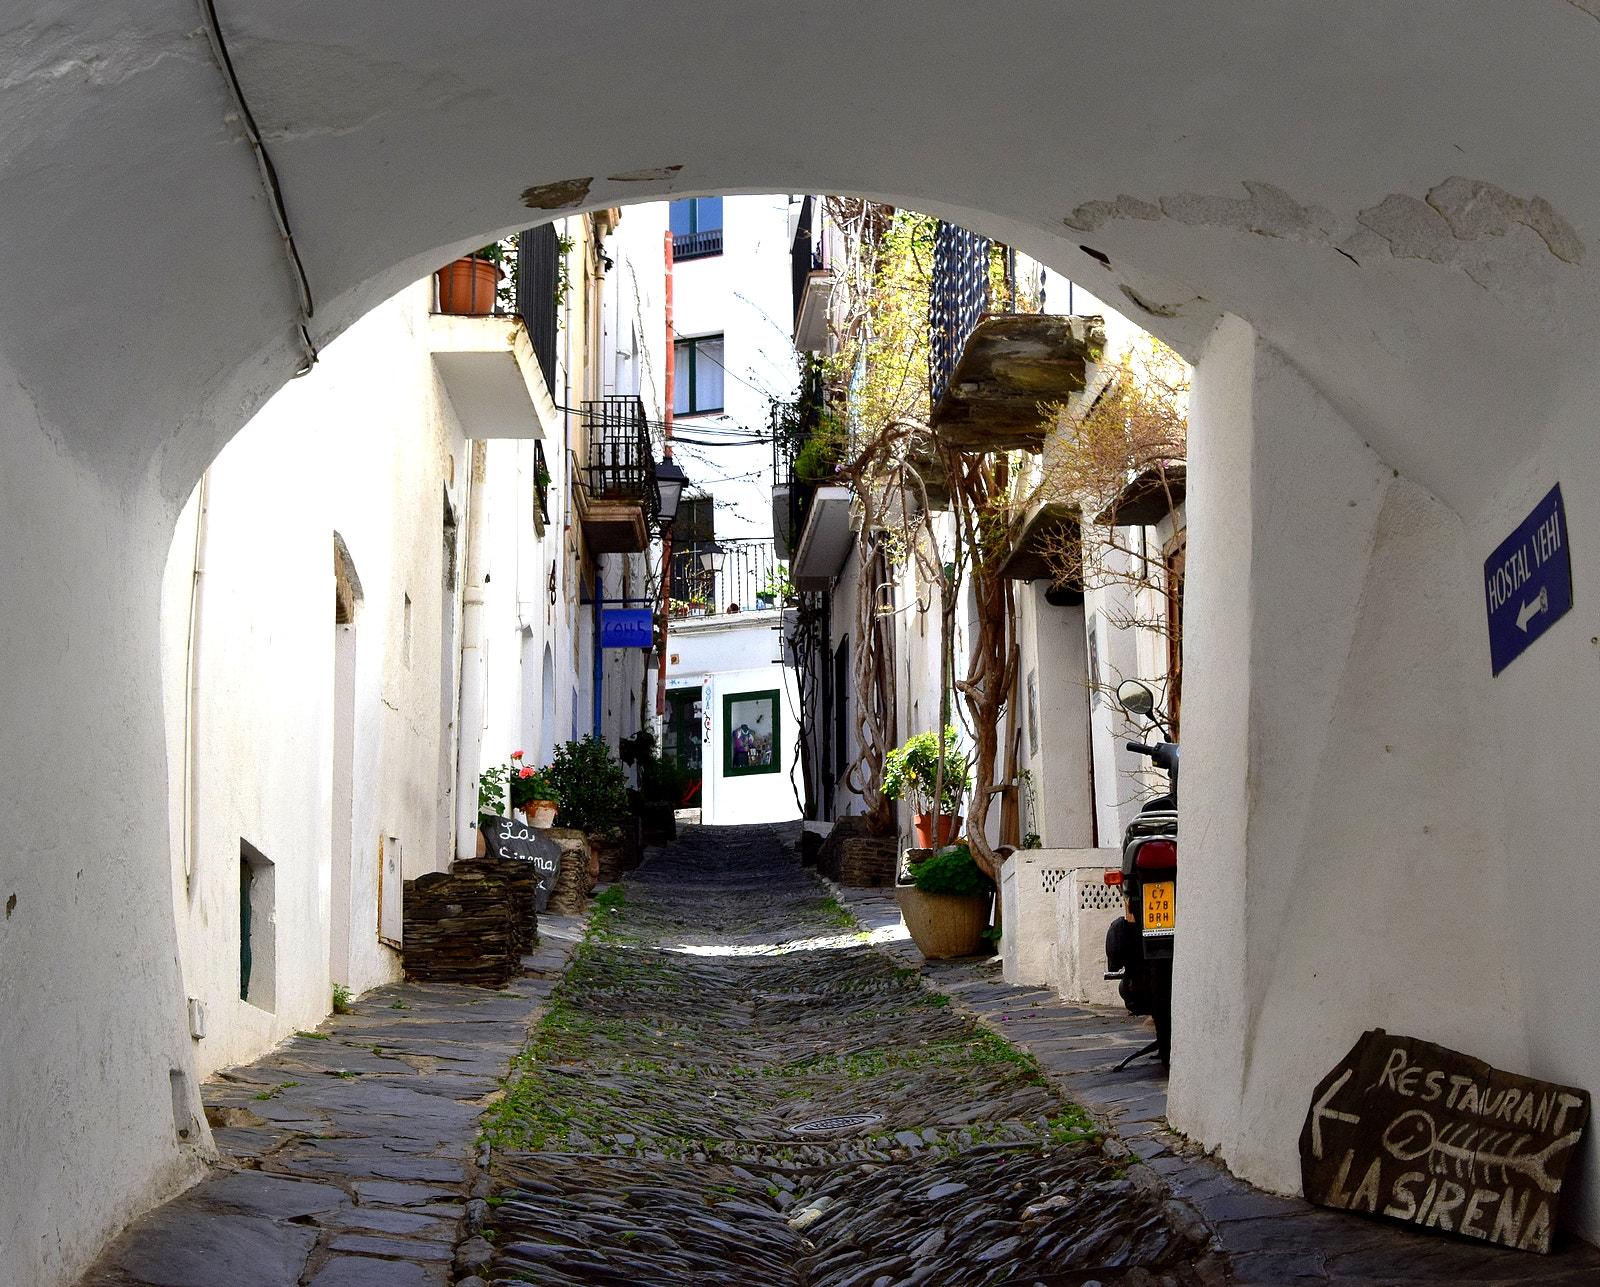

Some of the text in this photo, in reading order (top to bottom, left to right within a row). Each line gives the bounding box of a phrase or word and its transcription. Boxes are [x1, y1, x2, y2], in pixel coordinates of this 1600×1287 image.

[1488, 544, 1532, 614] HOSTAL
[499, 821, 535, 842] La
[1152, 888, 1165, 899] C7
[1149, 911, 1168, 923] BRH
[1378, 1048, 1583, 1136] RESTAURANT
[1324, 1148, 1552, 1255] LA SIRENA
